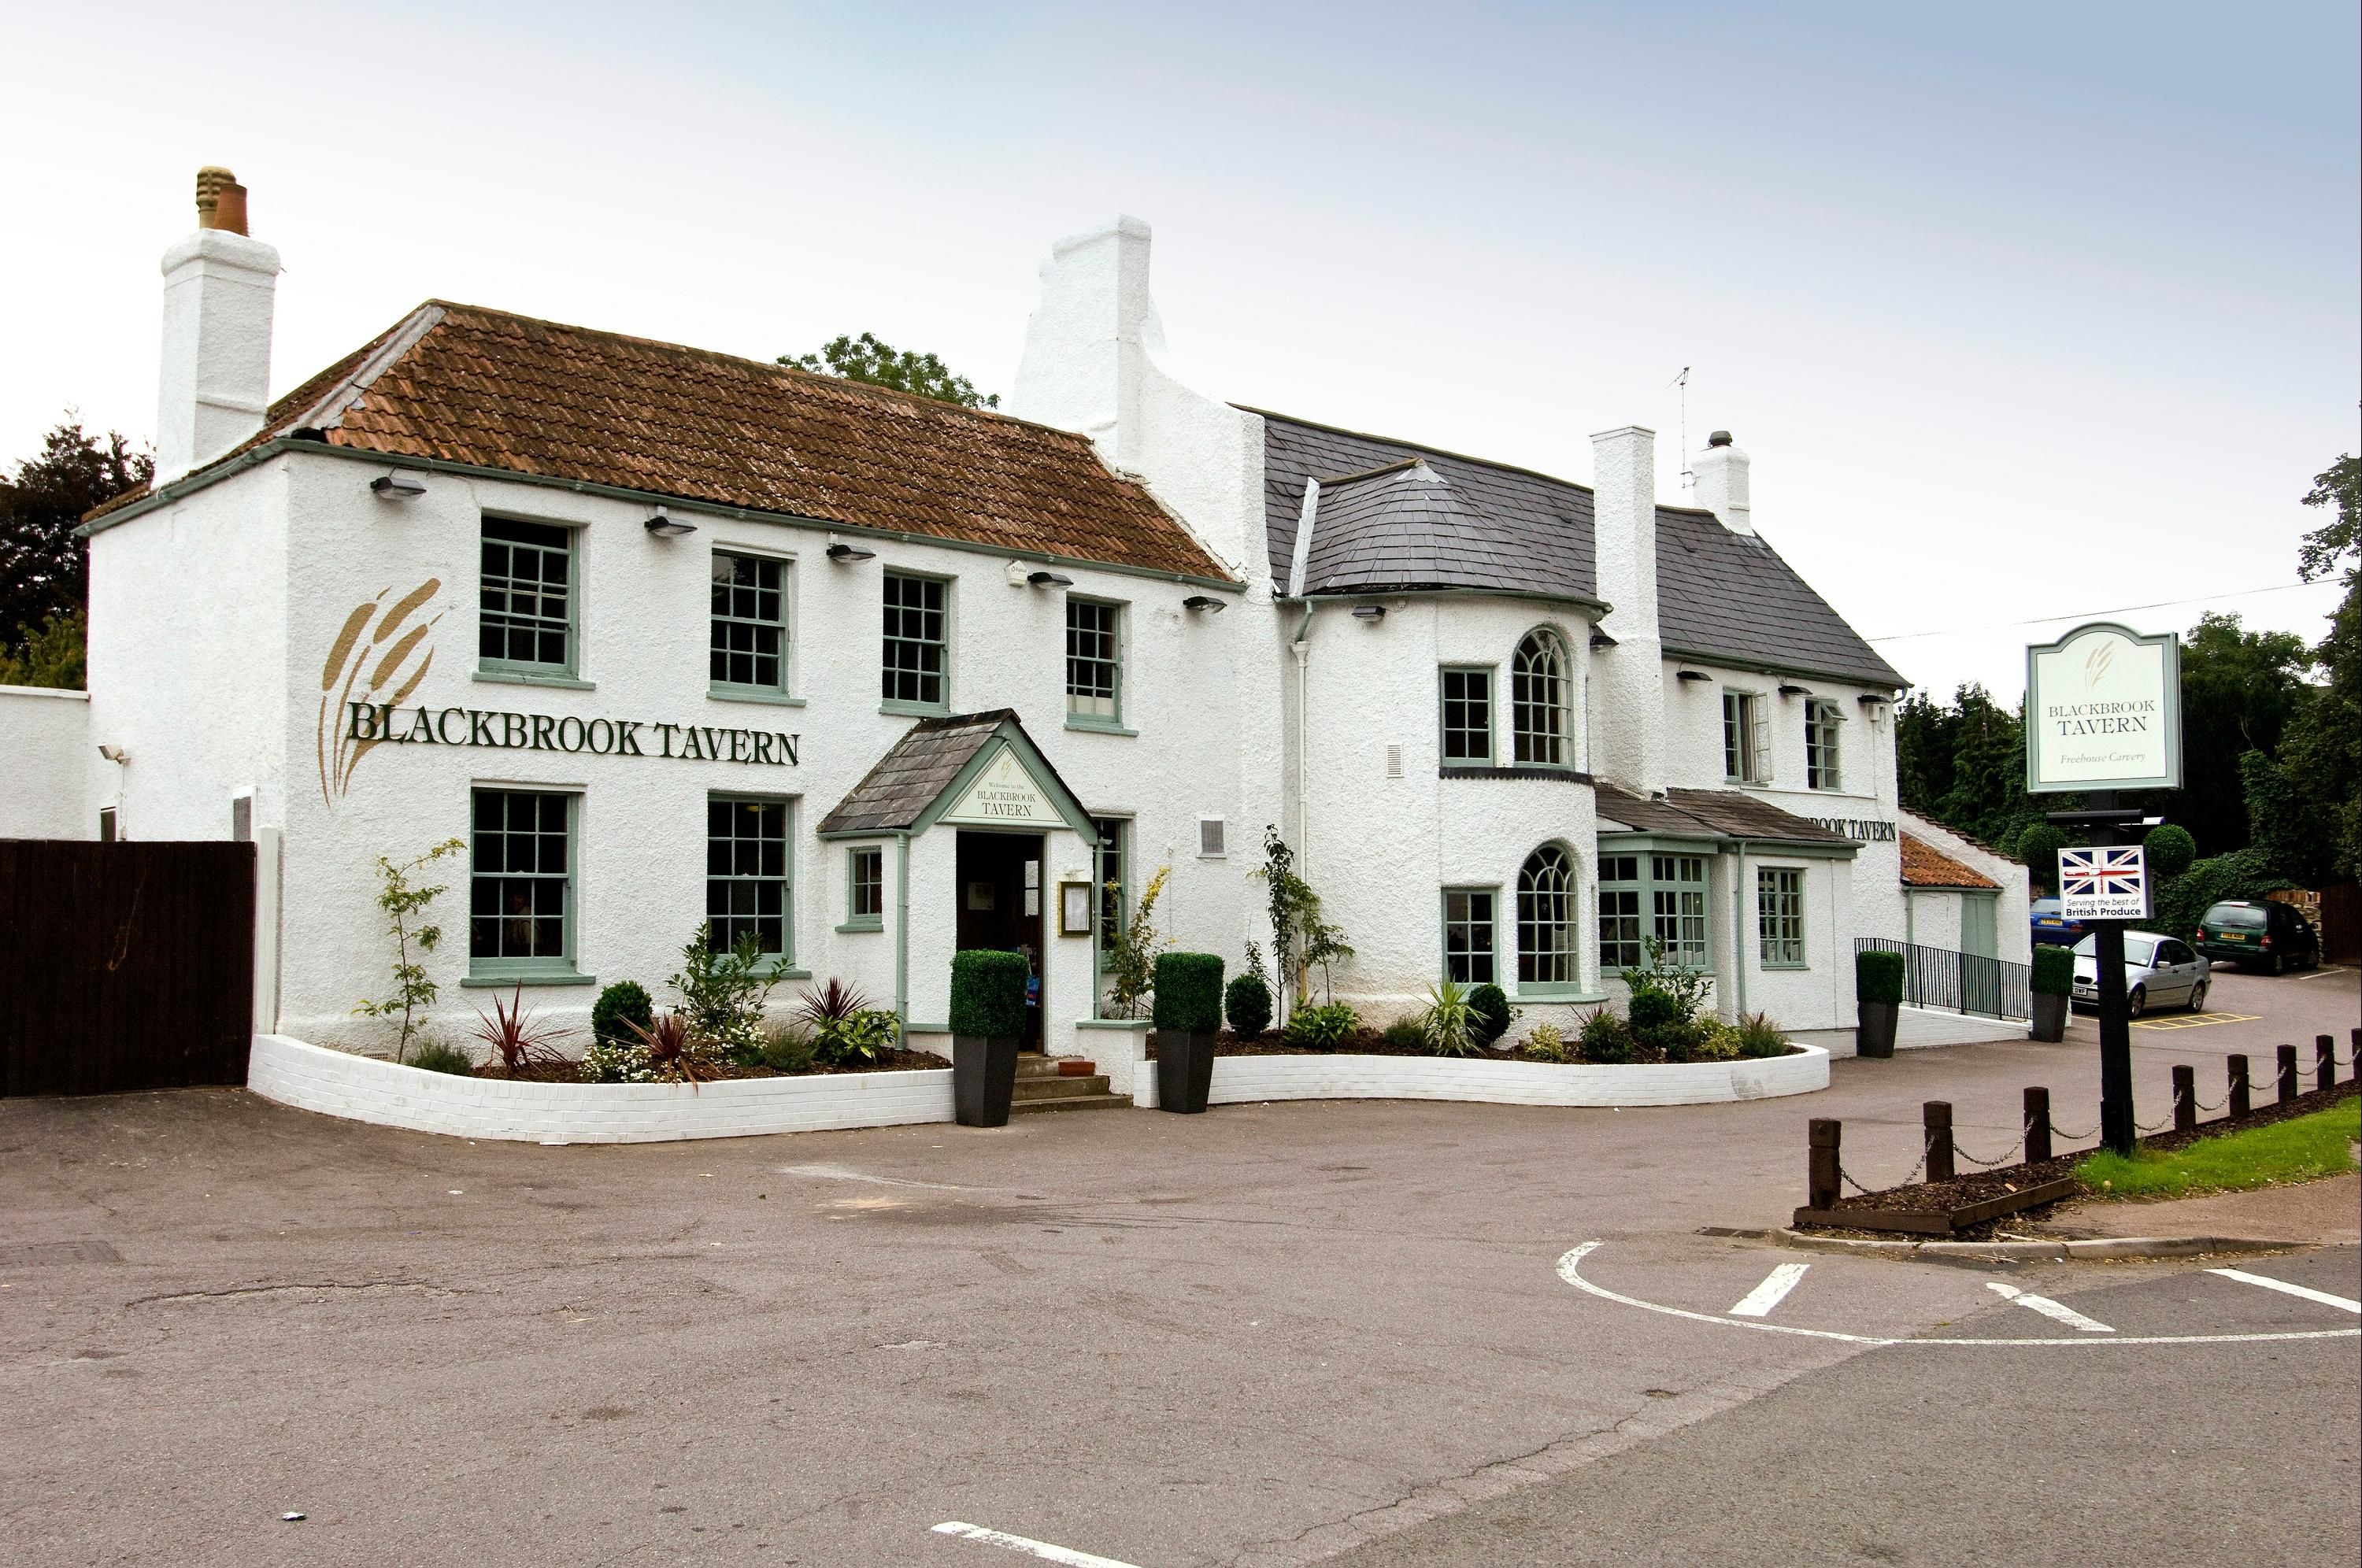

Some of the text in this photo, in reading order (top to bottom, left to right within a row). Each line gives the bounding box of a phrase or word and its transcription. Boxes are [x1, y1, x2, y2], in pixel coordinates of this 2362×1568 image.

[2048, 700, 2155, 718] BLACKBROOK
[2057, 716, 2147, 736] TAVERN
[346, 701, 802, 767] BLACKBROOK TAVERN
[2060, 752, 2146, 764] Freehouse Carvery
[977, 790, 1036, 802] BLACKBROOK
[982, 802, 1031, 816] TAVERN
[1849, 819, 1896, 841] TAVERN
[2067, 899, 2095, 908] Serving
[2066, 907, 2142, 916] British Produce
